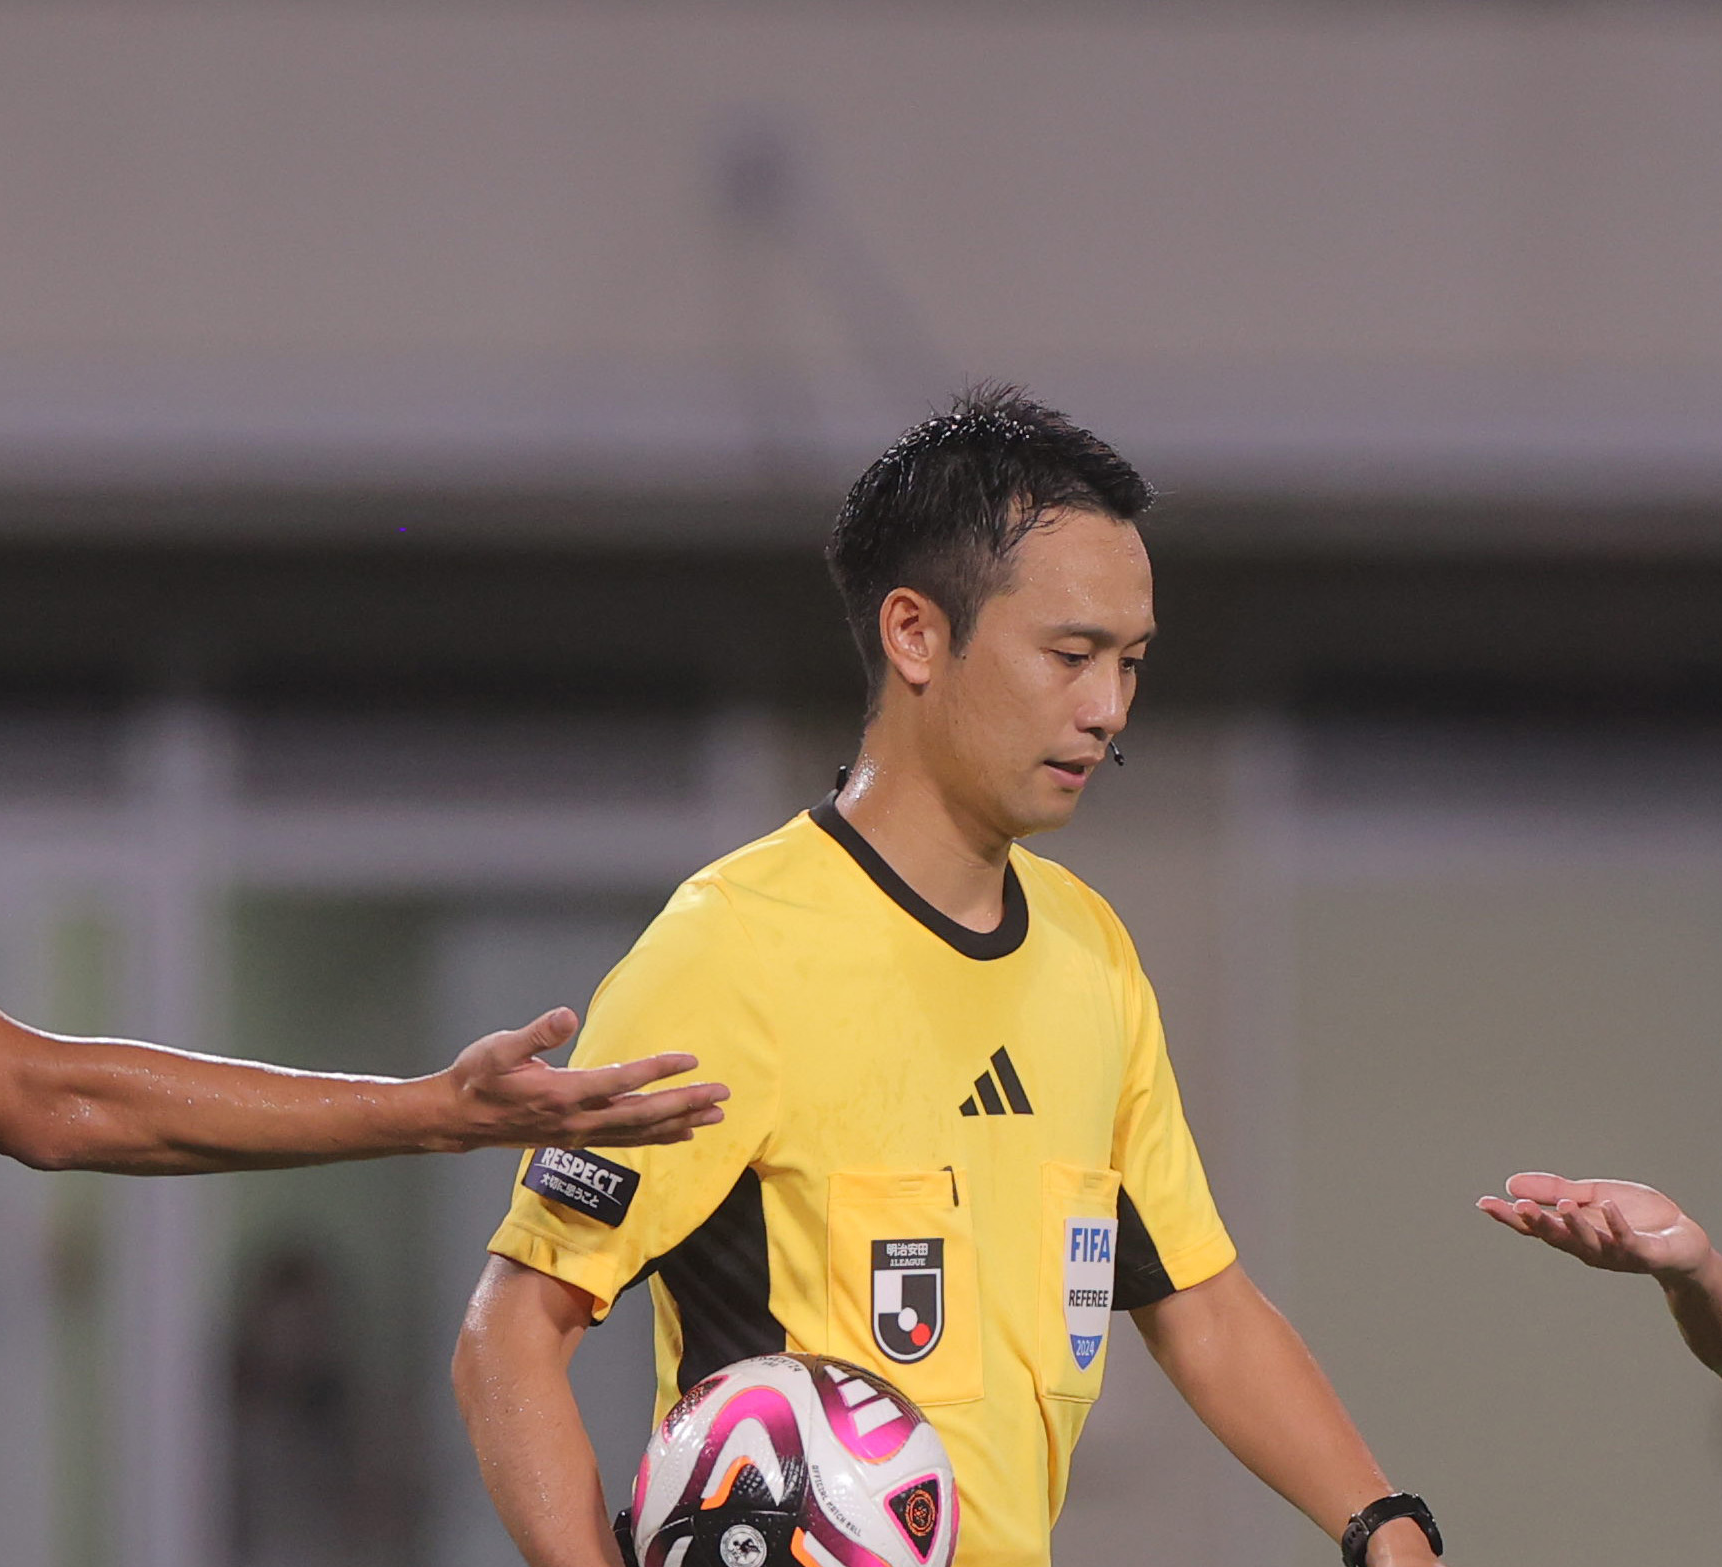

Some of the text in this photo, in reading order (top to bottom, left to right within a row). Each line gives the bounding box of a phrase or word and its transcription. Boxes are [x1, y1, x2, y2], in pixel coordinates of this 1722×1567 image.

[541, 1147, 623, 1195] RESPECT
[886, 1243, 929, 1257] 明治安田
[1070, 1227, 1111, 1263] FIFA
[1068, 1289, 1109, 1308] REFEREE
[1075, 1340, 1096, 1357] 2024
